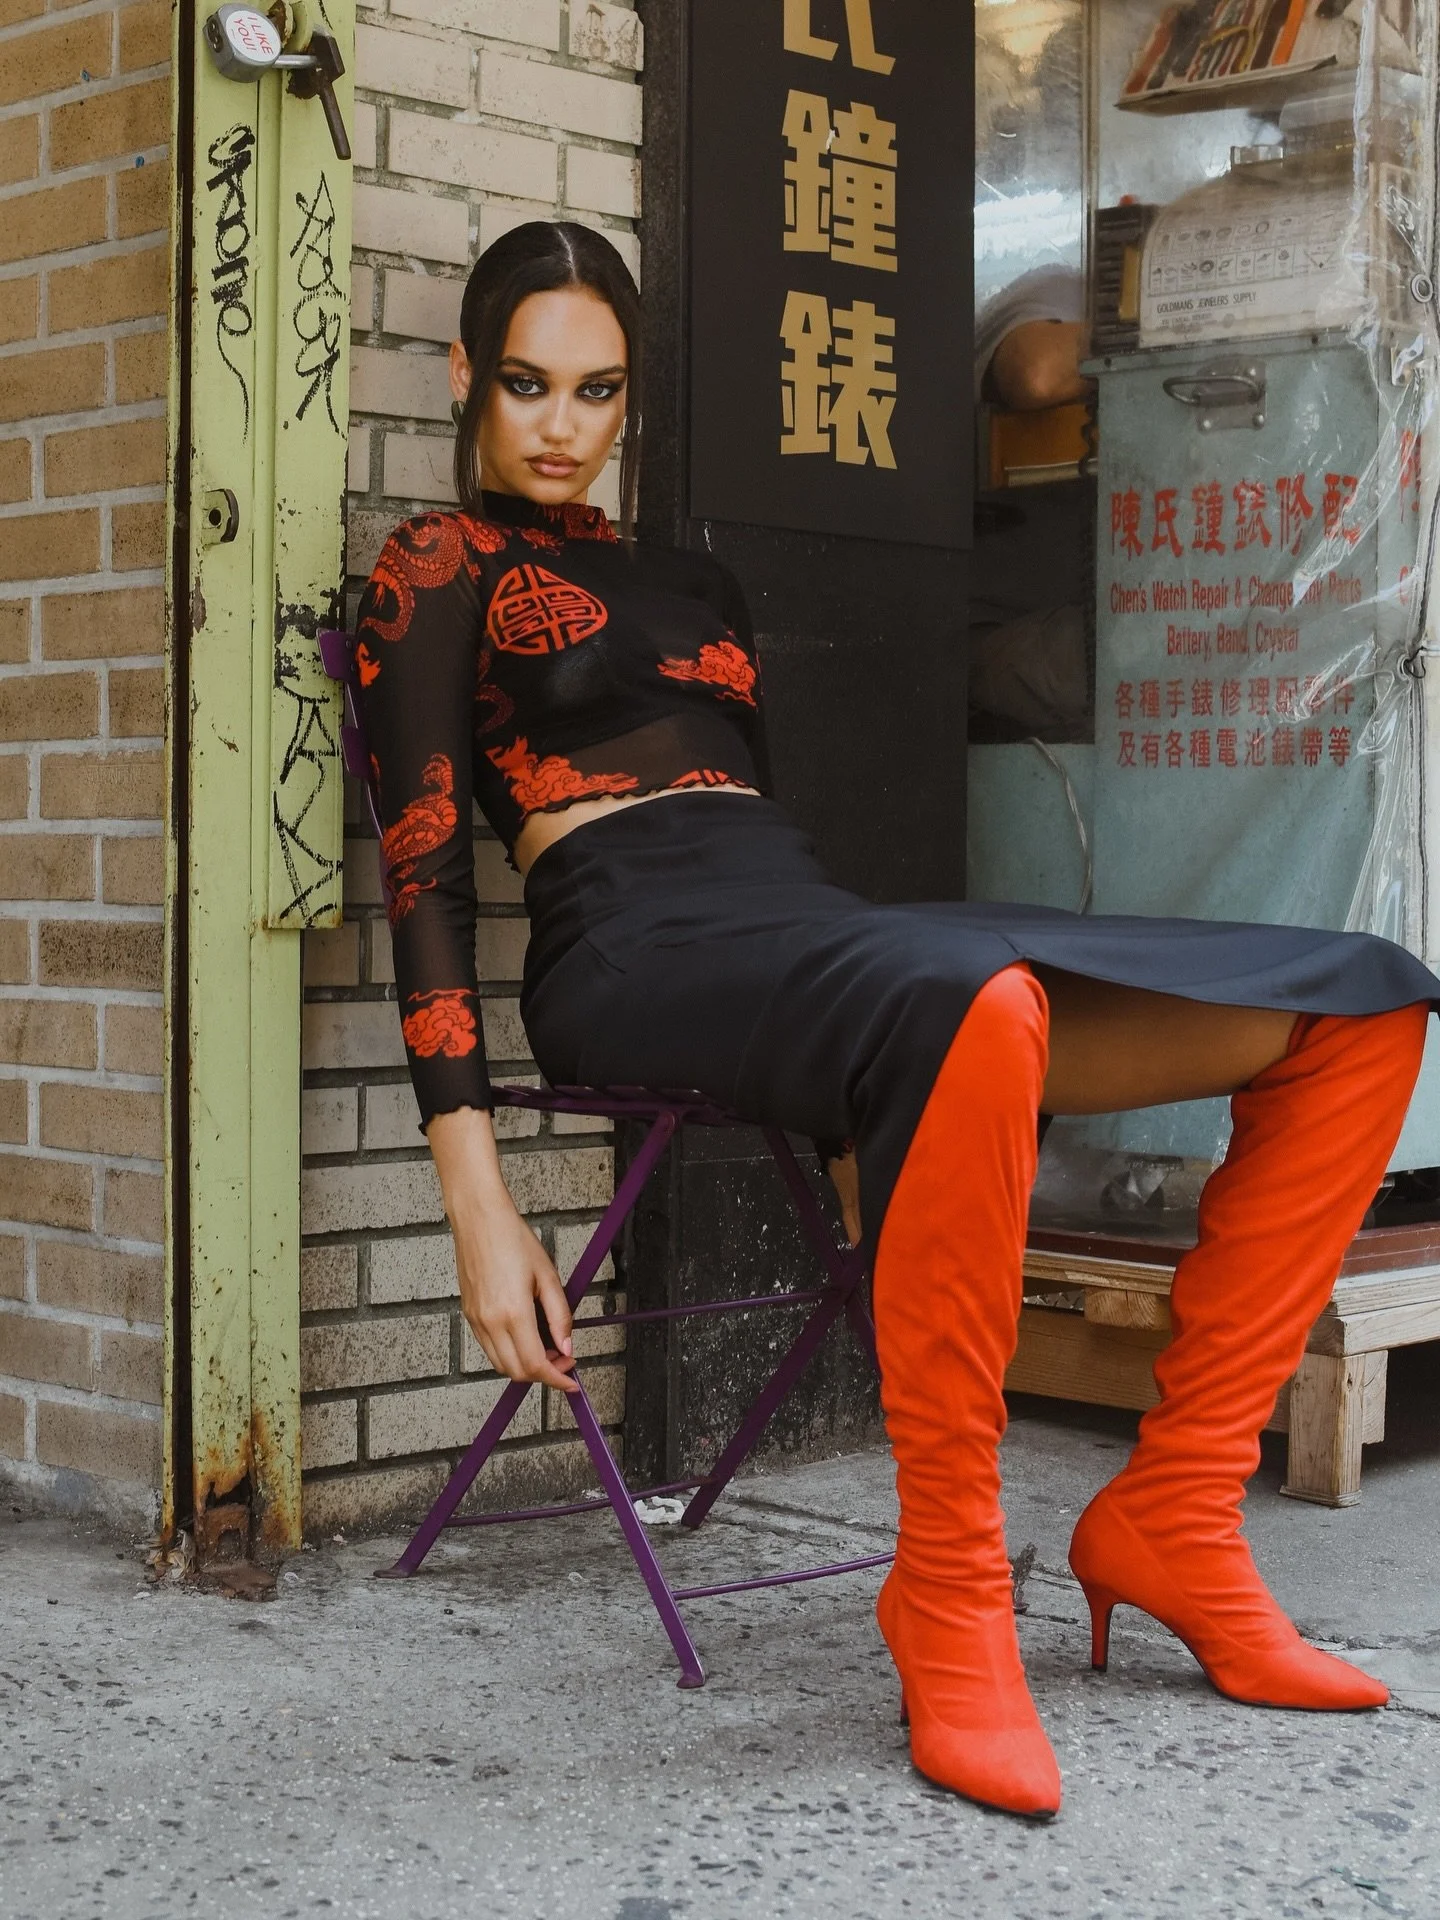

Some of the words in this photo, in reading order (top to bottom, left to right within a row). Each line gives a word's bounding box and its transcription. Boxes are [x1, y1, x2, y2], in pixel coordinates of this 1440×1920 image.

[250, 24, 274, 54] LIKE
[1233, 291, 1257, 304] SUPPLY
[1109, 581, 1147, 614] Chen's
[1152, 579, 1187, 613] Watch
[1191, 576, 1229, 618] Repair
[1234, 575, 1242, 608] &
[1247, 574, 1294, 613] Change
[1256, 620, 1299, 662] Crystal
